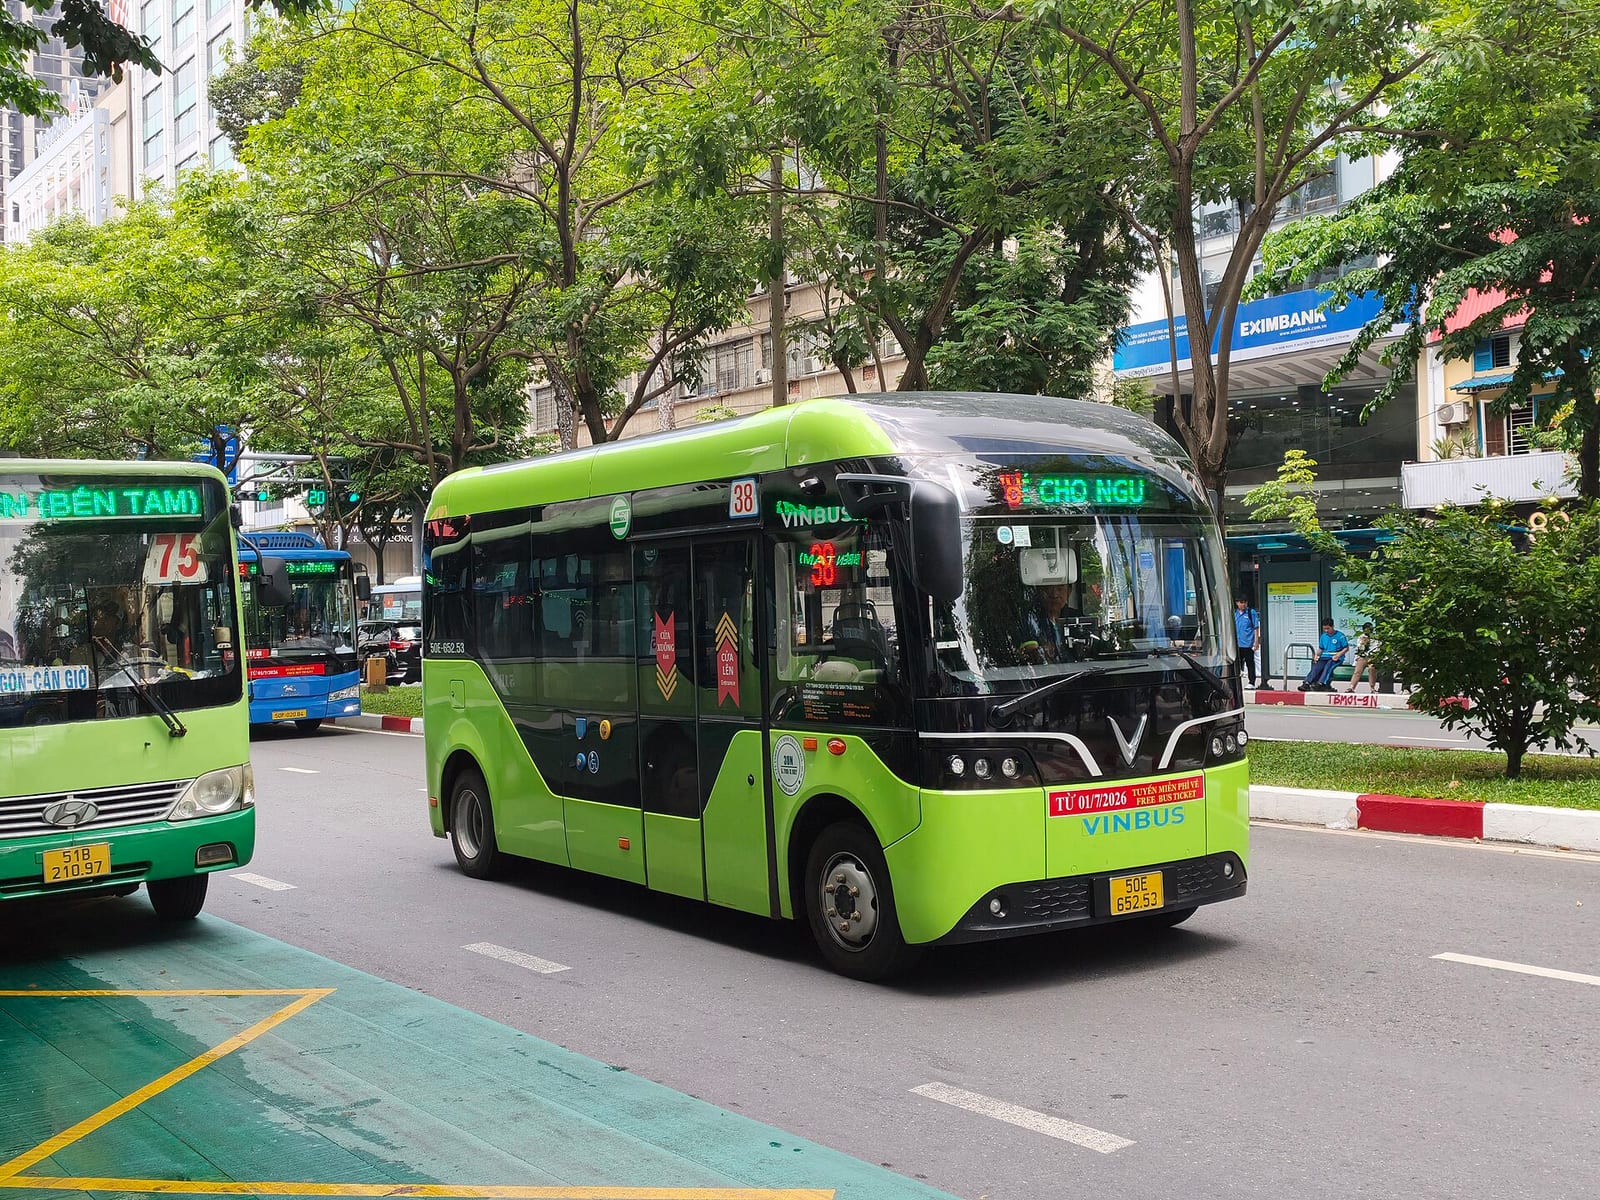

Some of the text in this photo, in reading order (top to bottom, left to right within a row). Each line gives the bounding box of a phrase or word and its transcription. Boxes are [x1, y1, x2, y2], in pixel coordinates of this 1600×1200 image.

[1240, 308, 1326, 337] EXIMBANK
[309, 490, 326, 505] 20
[734, 483, 753, 513] 38
[780, 505, 851, 529] VINBUS
[155, 534, 200, 578] 75
[430, 642, 465, 654] 50E-652.53
[722, 663, 734, 676] LÊN
[1055, 791, 1127, 812] TỪ 01/7/2026
[1136, 790, 1196, 806] FREE BUS TICKET
[1082, 806, 1185, 836] VINBUS
[62, 848, 90, 863] 51B
[52, 861, 102, 880] 210.97
[1126, 876, 1147, 893] 50E
[1117, 892, 1157, 911] 652.53
